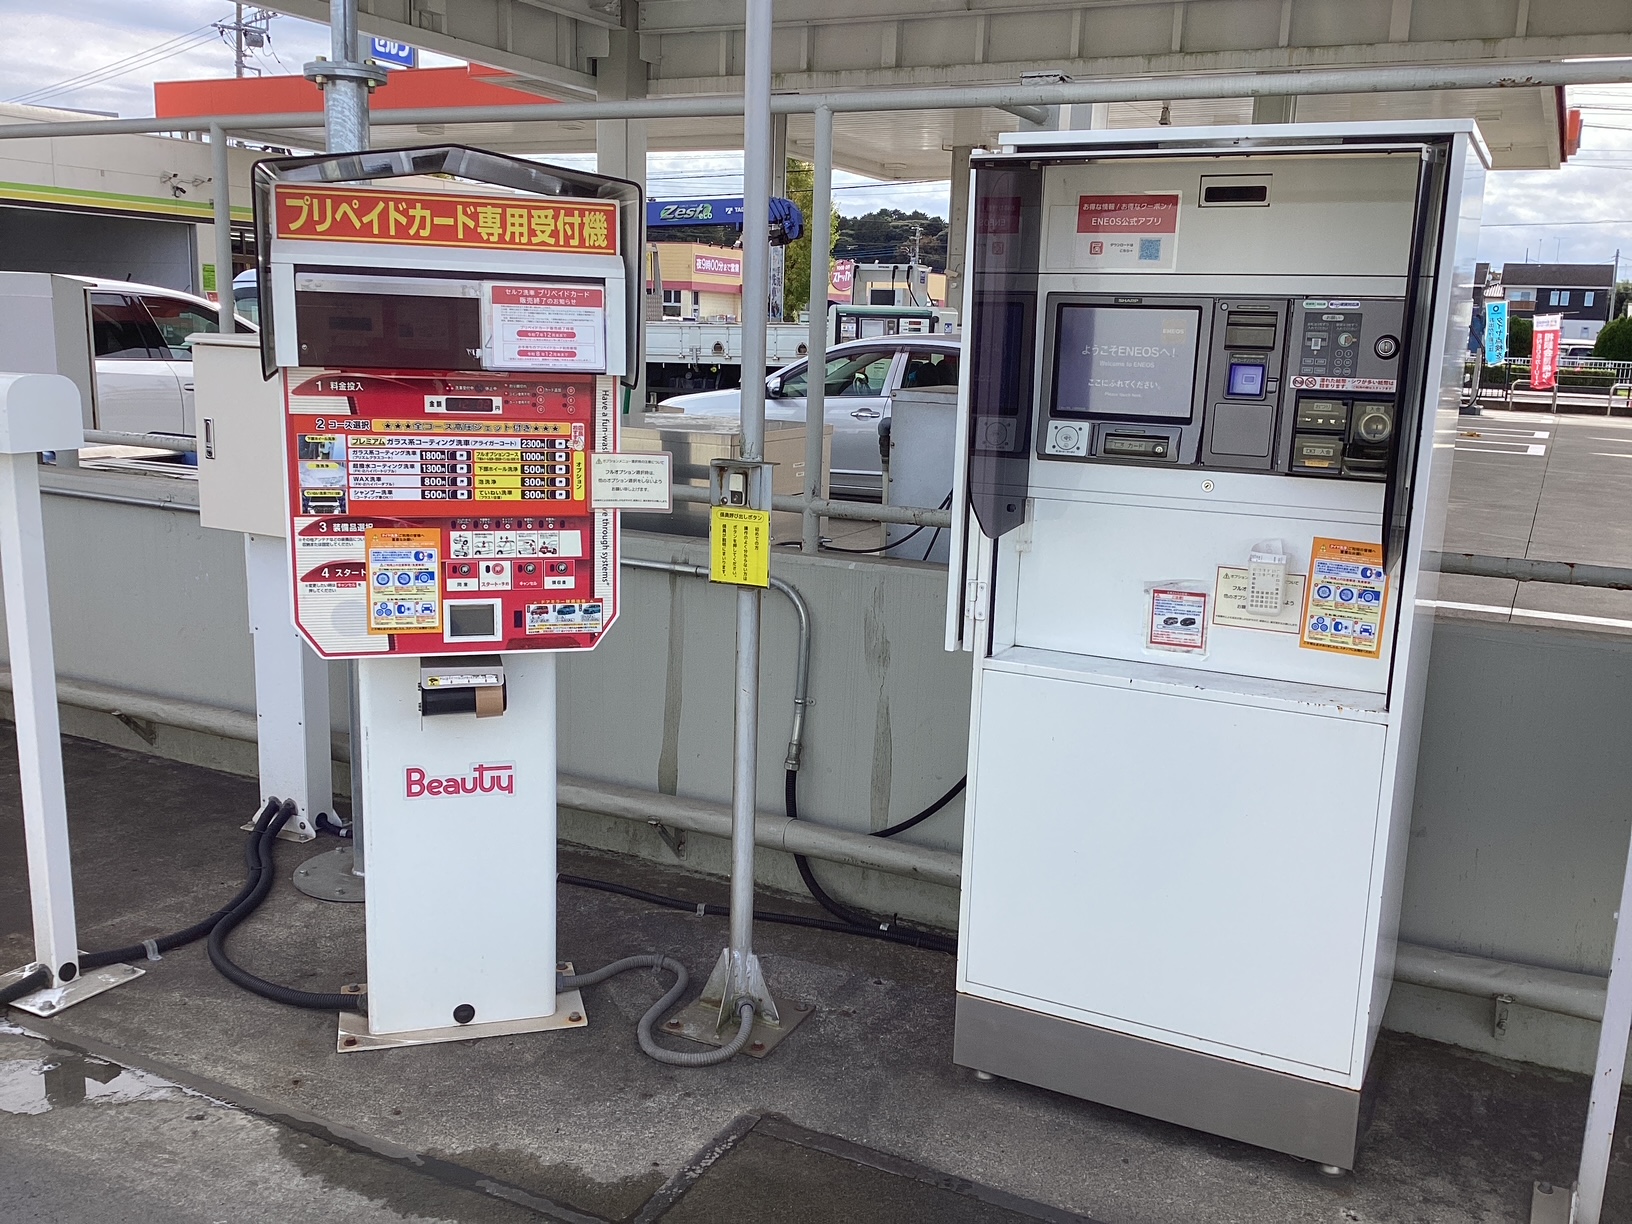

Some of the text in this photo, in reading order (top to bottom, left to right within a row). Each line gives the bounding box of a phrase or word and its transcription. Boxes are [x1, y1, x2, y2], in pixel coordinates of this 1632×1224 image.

[285, 197, 609, 248] プリペイドカード専用受付機
[1091, 217, 1162, 226] ENEOS公式アプリ
[832, 271, 852, 283] ストッカ
[505, 288, 590, 299] セルフ洗車 プリペイドカード
[519, 297, 577, 306] 販売終了のお知らせ
[1081, 344, 1176, 359] ようこそENEOSへ!
[1100, 360, 1125, 368] Welcome
[316, 381, 364, 391] 1 料金投入
[1087, 378, 1162, 390] ここにふれてください。
[601, 389, 610, 411] Have
[316, 417, 371, 431] 2 コース選択
[351, 437, 386, 446] プレミアム
[521, 439, 545, 449] 2300円
[421, 451, 446, 460] 1800円
[521, 452, 545, 461] 1000円
[422, 464, 446, 473] 1300円
[523, 465, 545, 474] 500円
[424, 477, 446, 486] 800円
[523, 478, 545, 486] 300円
[424, 490, 446, 499] 500円
[523, 490, 545, 499] 300円
[719, 512, 763, 521] 係員呼び出しボタン
[319, 522, 327, 532] 3
[599, 518, 610, 550] through
[321, 568, 367, 579] 4 スタート
[406, 763, 514, 798] Beauty
